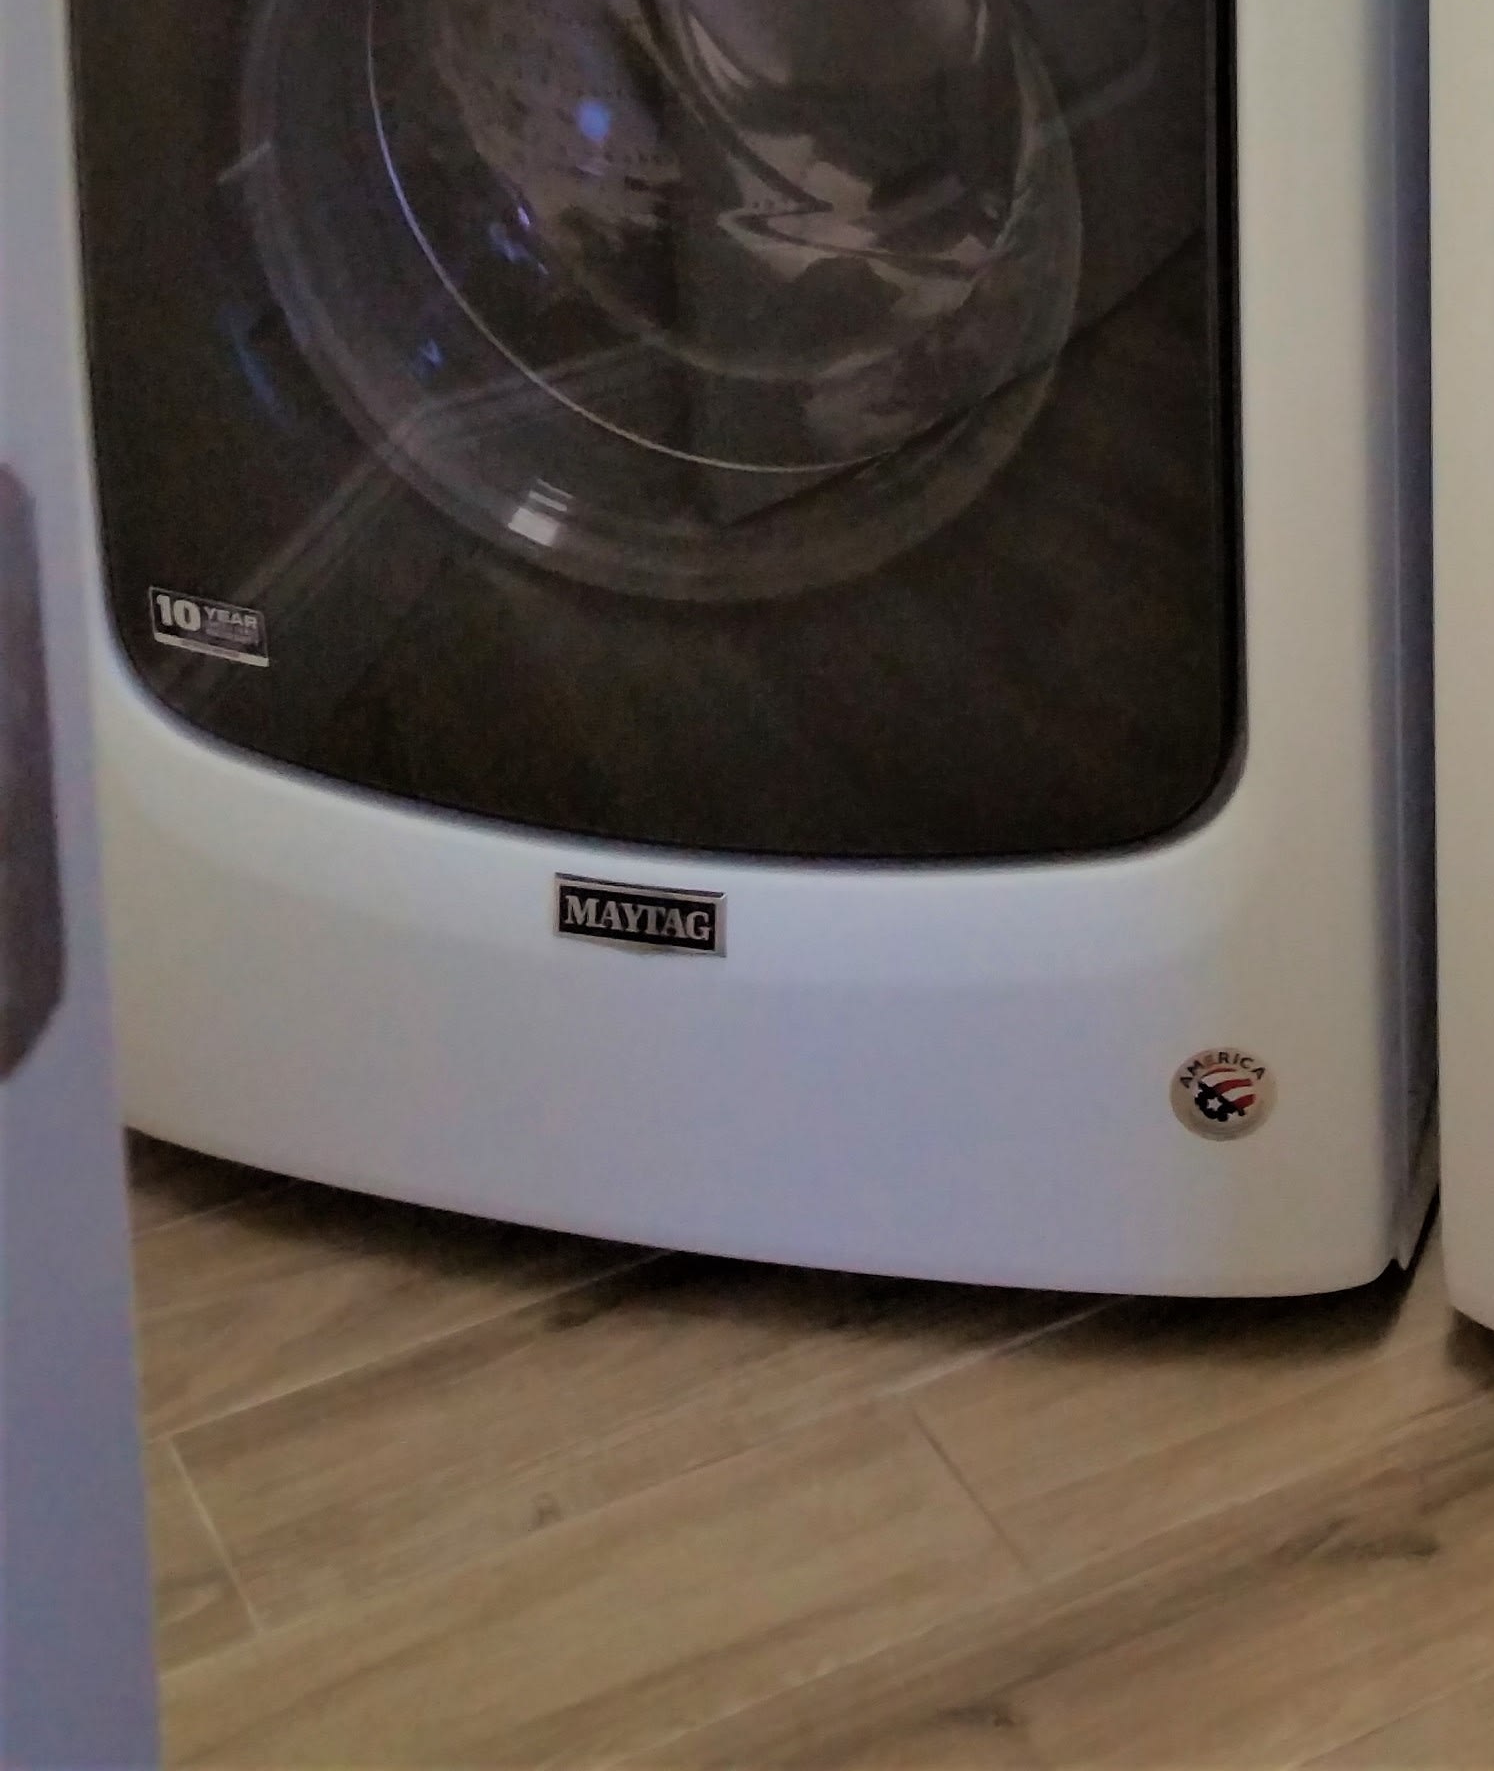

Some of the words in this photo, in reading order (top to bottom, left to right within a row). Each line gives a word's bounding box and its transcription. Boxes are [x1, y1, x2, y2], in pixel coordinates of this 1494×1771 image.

[156, 593, 202, 632] 10
[203, 606, 258, 629] YEAR
[564, 894, 713, 941] MAYTAG
